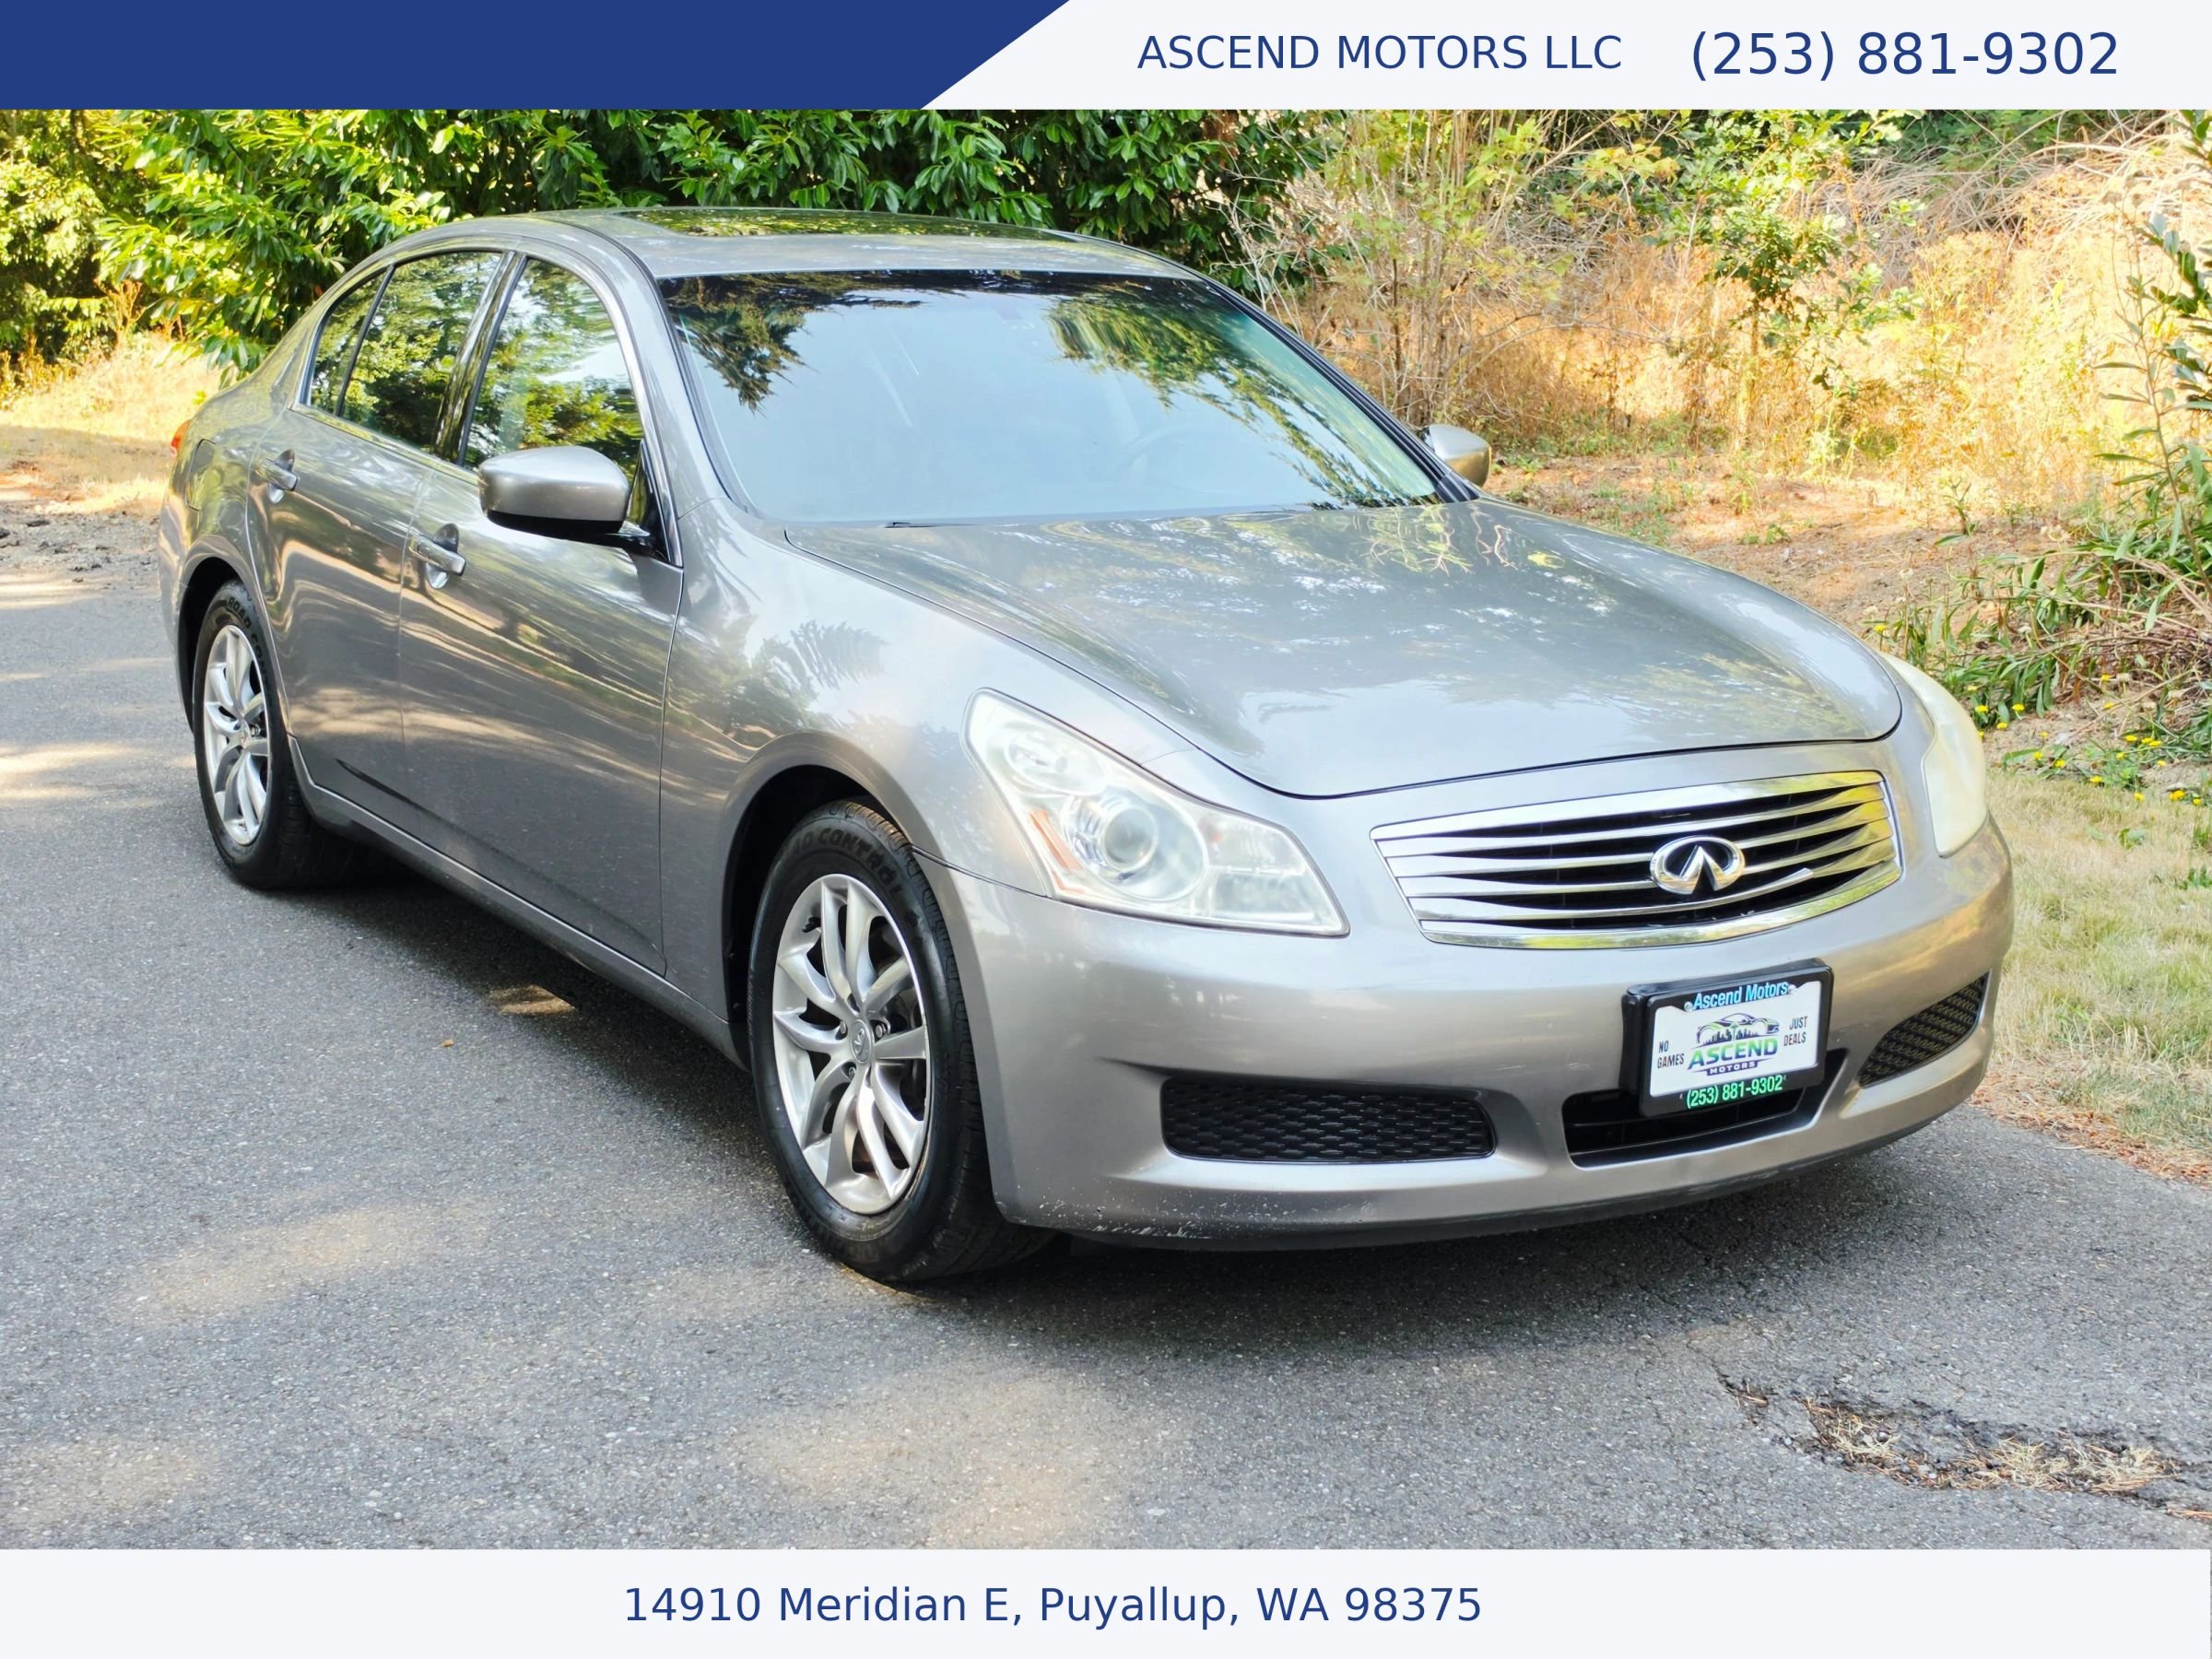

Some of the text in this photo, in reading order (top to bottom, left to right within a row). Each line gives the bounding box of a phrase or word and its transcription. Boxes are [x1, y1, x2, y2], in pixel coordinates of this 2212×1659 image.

[818, 828, 902, 897] CONTROL
[1692, 981, 1789, 1010] Ascend Motors
[1789, 1016, 1808, 1030] JUST
[1783, 1032, 1806, 1046] DEALS
[1659, 1041, 1669, 1053] NO
[1687, 1038, 1778, 1070] ASCEND
[1657, 1053, 1685, 1068] GAMES
[1710, 1061, 1756, 1075] MOTORS
[1687, 1074, 1783, 1109] (253) 881-9302
